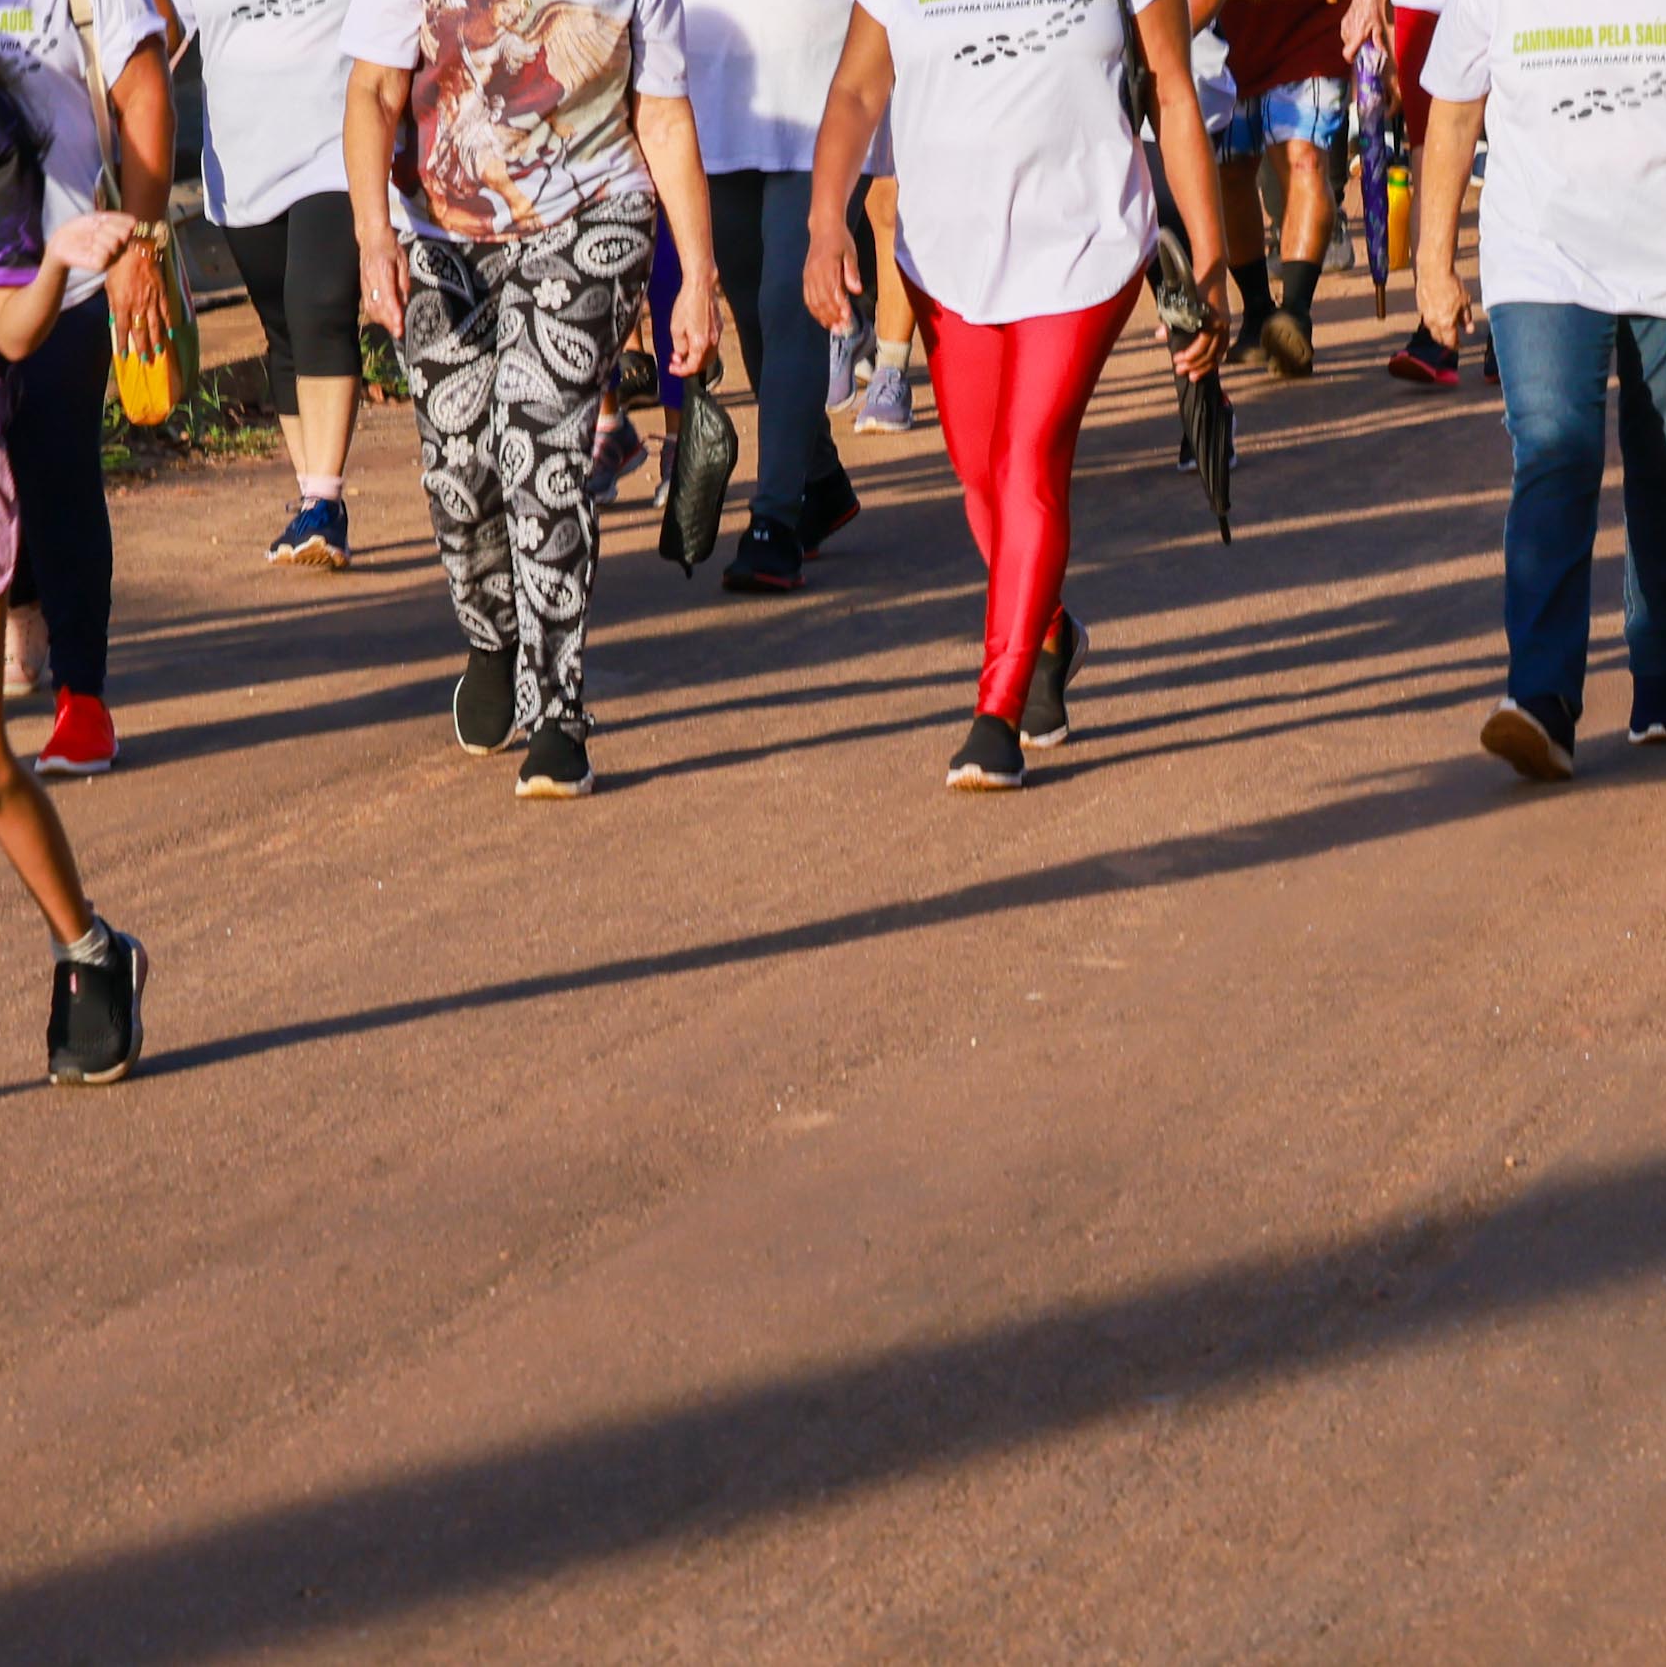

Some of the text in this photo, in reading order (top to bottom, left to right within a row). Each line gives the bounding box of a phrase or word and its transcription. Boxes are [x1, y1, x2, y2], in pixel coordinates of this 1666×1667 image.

[957, 3, 981, 13] PARA
[983, 0, 1030, 11] QUALIDADE
[1513, 25, 1593, 55] CAMINHADA
[1598, 23, 1631, 46] PELA
